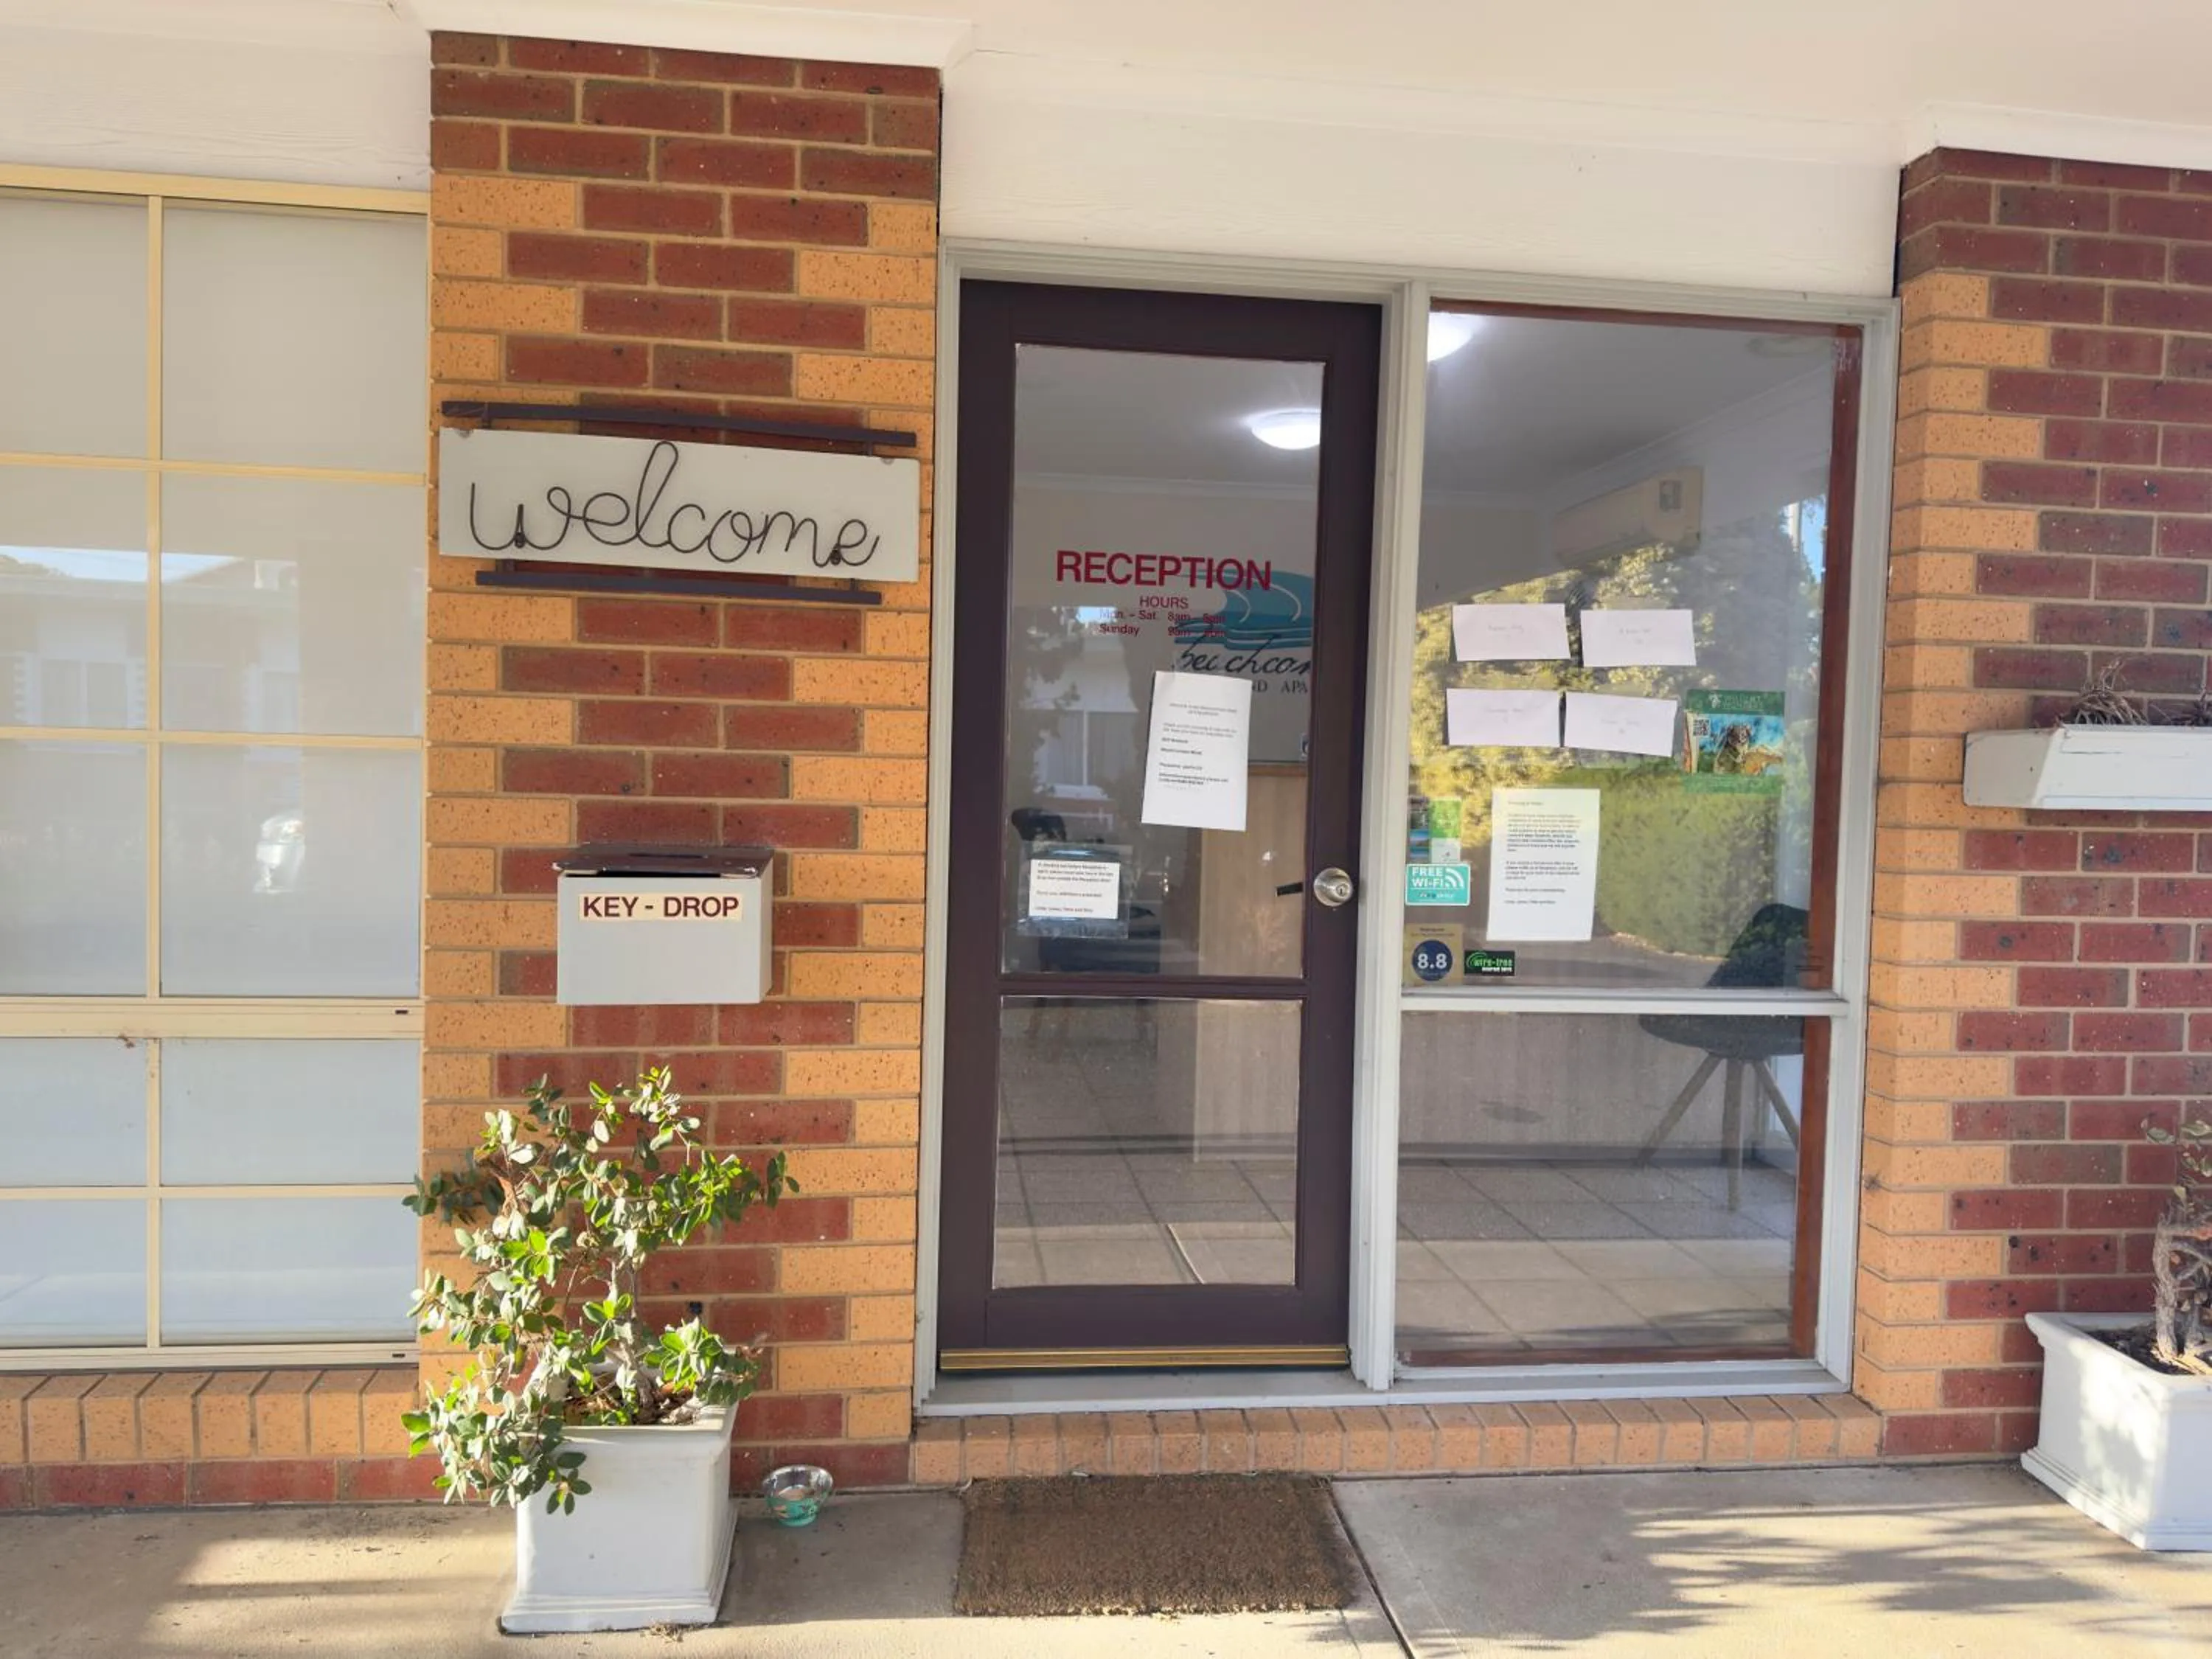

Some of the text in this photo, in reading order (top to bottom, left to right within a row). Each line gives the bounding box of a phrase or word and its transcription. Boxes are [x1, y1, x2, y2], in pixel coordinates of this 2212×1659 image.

[470, 441, 880, 568] welcome
[1056, 550, 1272, 591] RECEPTION
[1139, 595, 1189, 609] HOURS
[1099, 623, 1140, 637] Sunday
[1411, 866, 1444, 877] FREE
[1411, 877, 1444, 888] WI-FI
[582, 896, 639, 918] KEY
[663, 896, 740, 918] DROP
[1417, 953, 1447, 970] 8.8
